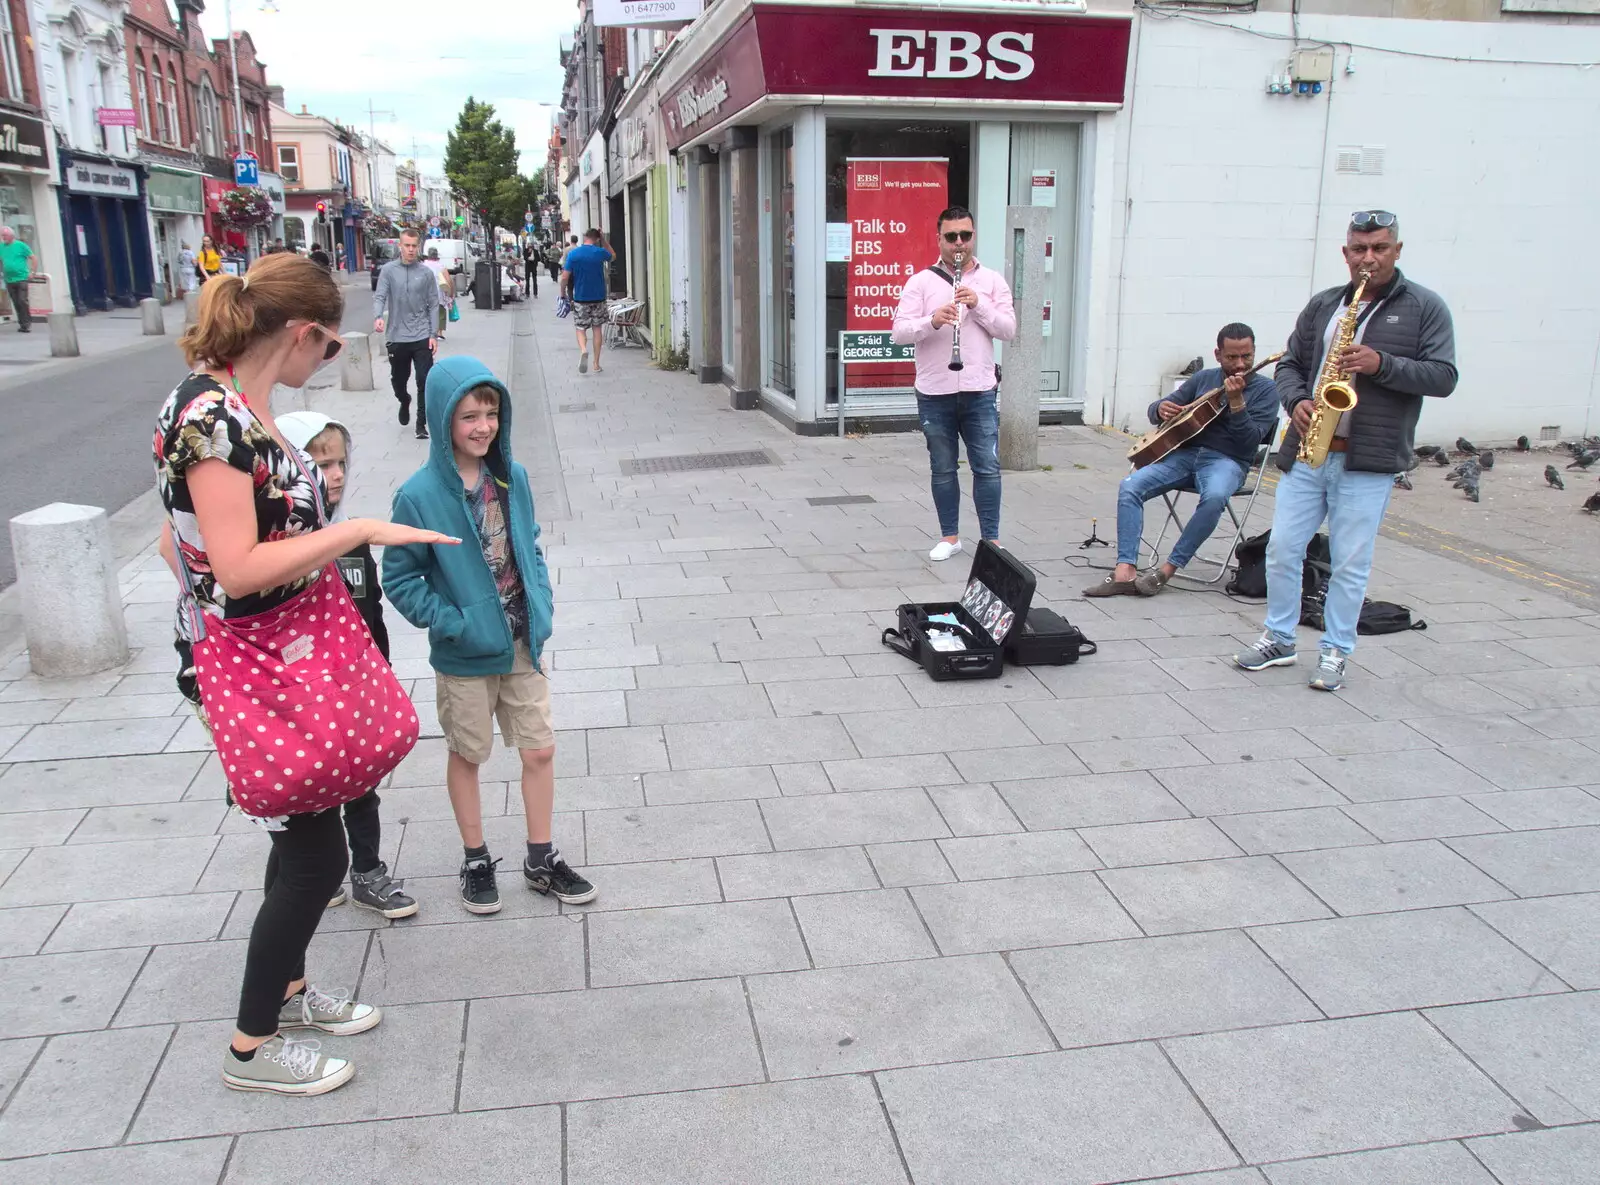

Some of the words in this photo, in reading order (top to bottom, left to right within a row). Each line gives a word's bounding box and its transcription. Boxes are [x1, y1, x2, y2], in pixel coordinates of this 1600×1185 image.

[624, 4, 635, 13] 01
[637, 2, 676, 13] 6477900
[868, 28, 1035, 81] EBS
[237, 163, 247, 177] P
[857, 174, 879, 182] EBS
[900, 181, 911, 189] get
[911, 181, 922, 189] you
[923, 180, 941, 188] home.
[854, 218, 885, 233] Talk
[889, 220, 906, 233] to
[855, 240, 882, 255] EBS
[854, 261, 900, 275] about
[905, 264, 914, 275] a
[854, 283, 903, 300] mortg
[854, 303, 899, 320] today
[857, 335, 882, 345] Sráid
[843, 347, 893, 357] GEORGE'S
[902, 347, 915, 356] ST
